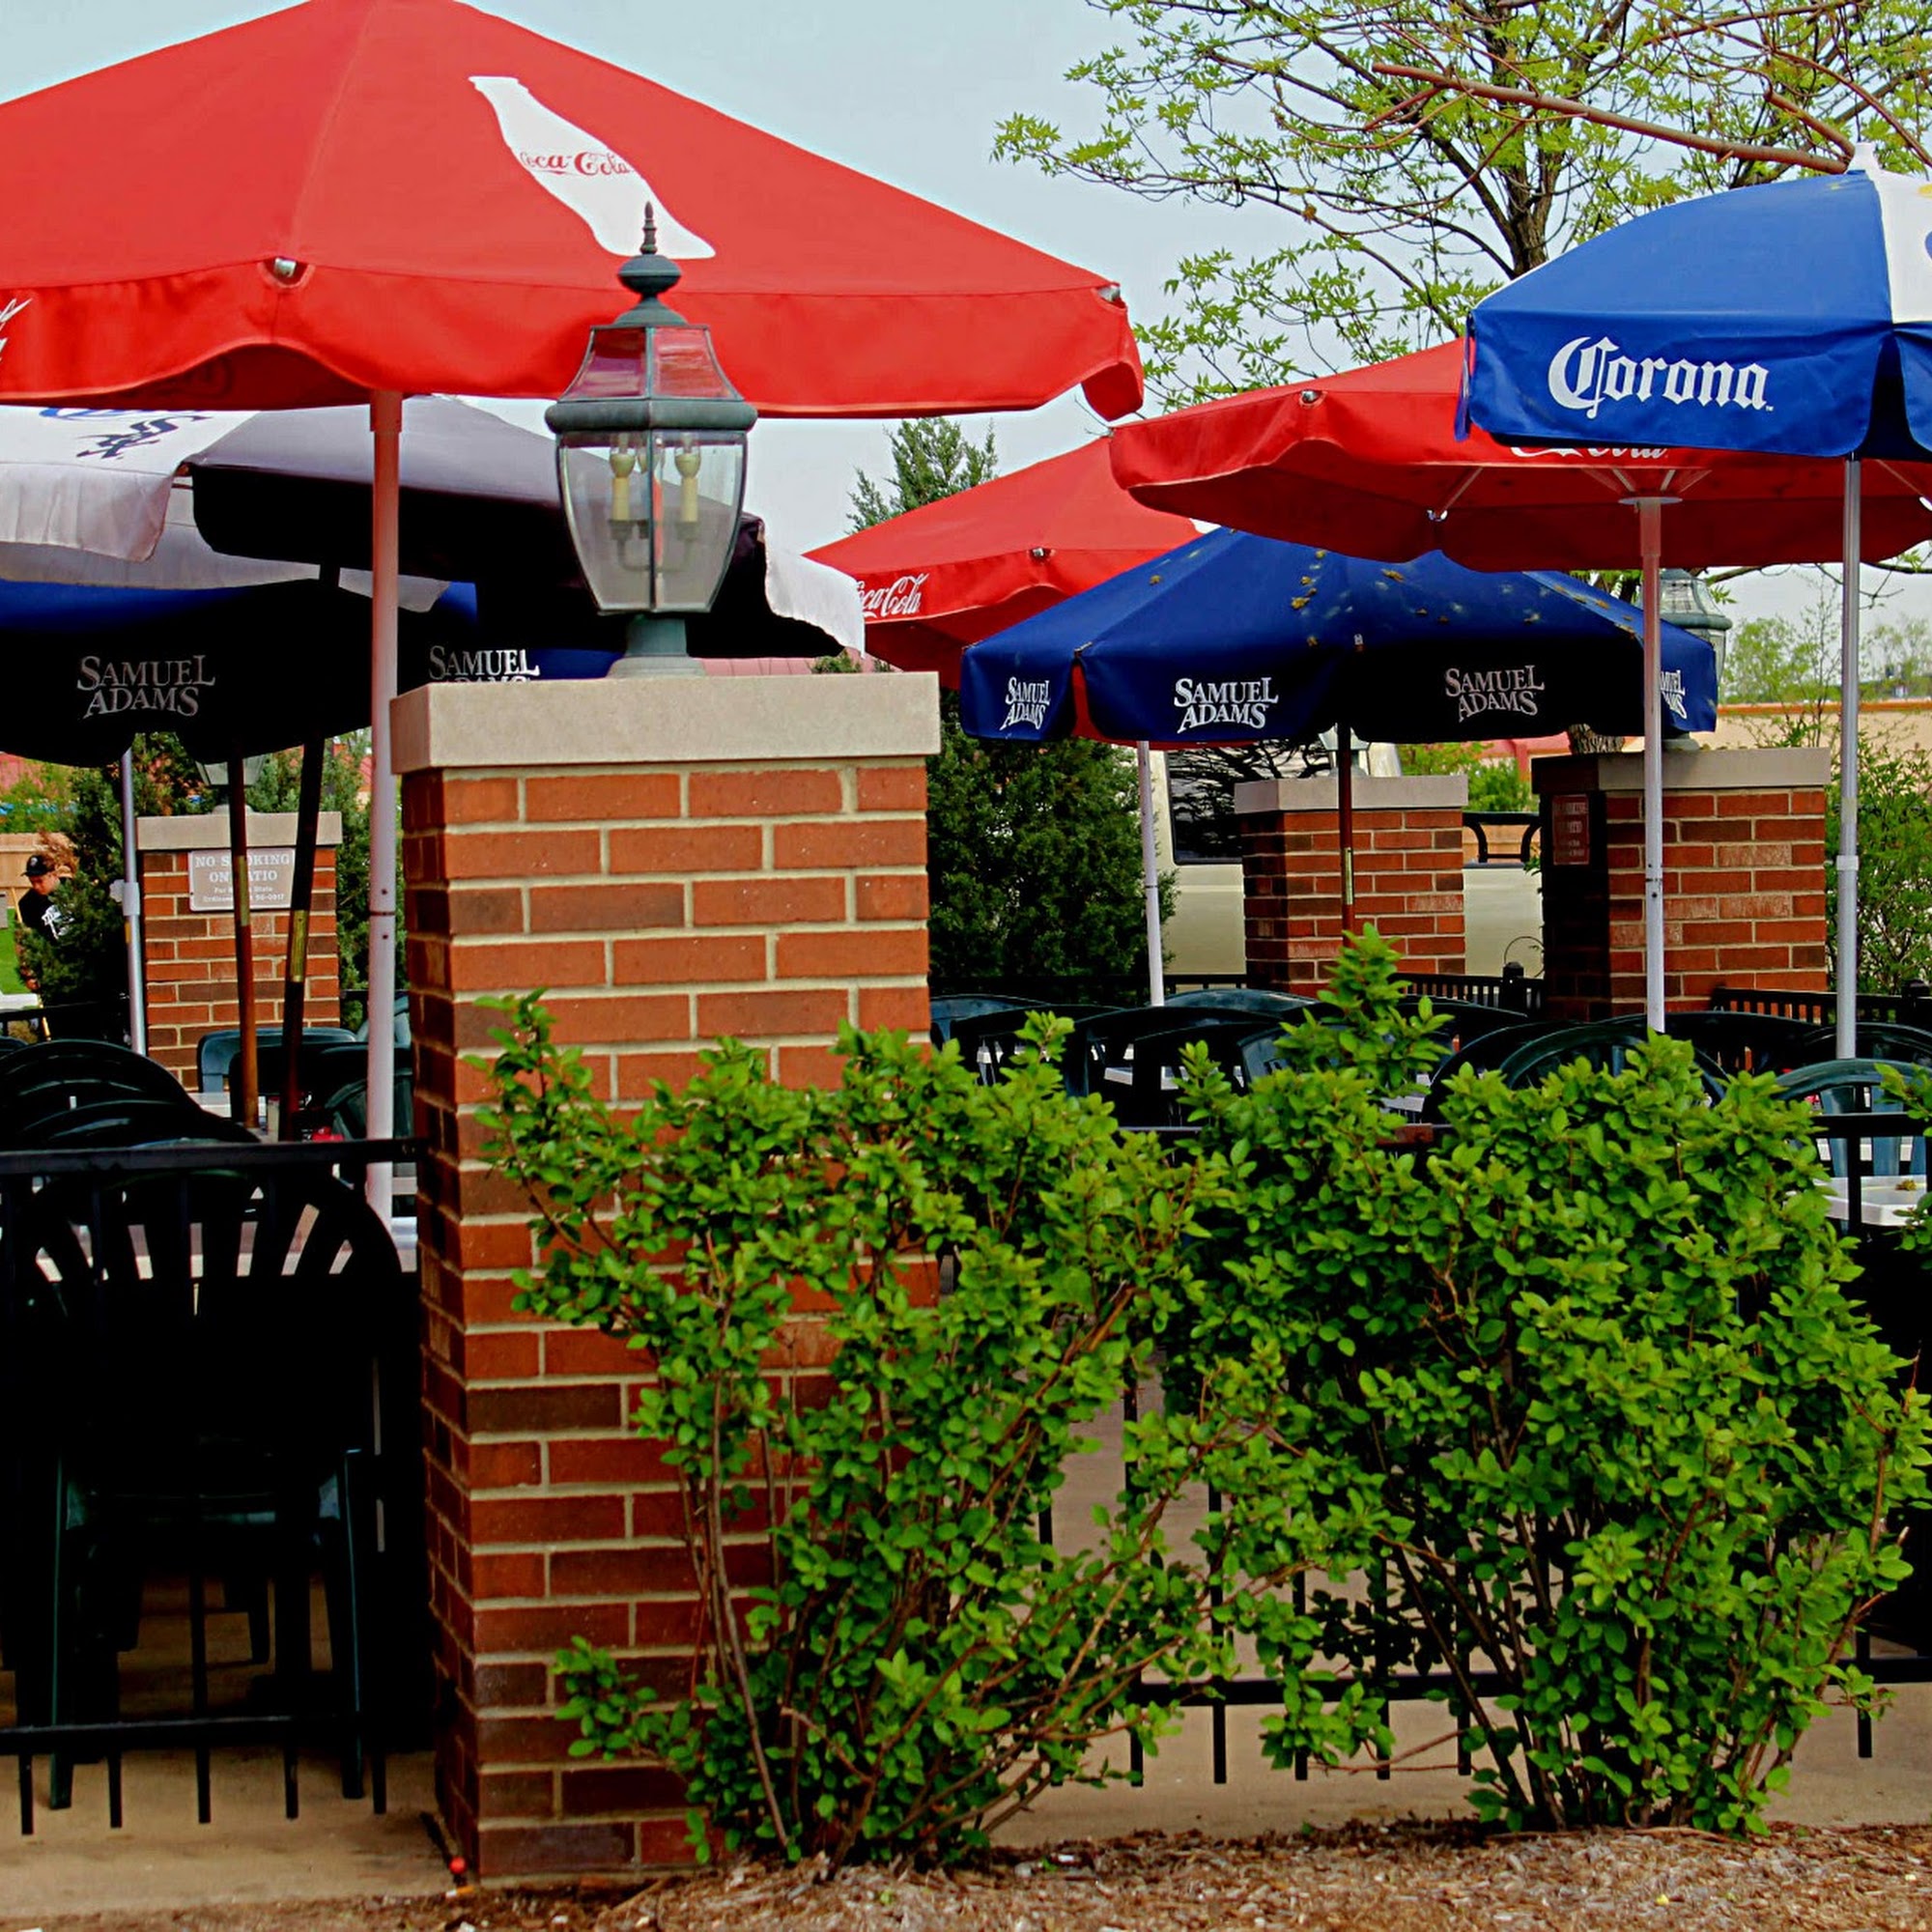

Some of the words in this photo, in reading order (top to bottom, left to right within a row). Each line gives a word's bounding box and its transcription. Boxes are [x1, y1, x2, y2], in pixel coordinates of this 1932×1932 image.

[520, 151, 630, 176] Coca-Cola
[1548, 336, 1770, 419] Corona
[76, 654, 216, 691] SAMUEL
[428, 644, 541, 680] SAMUEL
[1005, 676, 1051, 706] SAMUEL
[1174, 676, 1279, 707] SAMUEL
[1445, 665, 1546, 696] SAMUEL
[82, 686, 199, 719] ADAMS
[999, 703, 1046, 730] ADAMS
[1177, 703, 1268, 733] ADAMS
[1459, 691, 1538, 723] ADAMS
[195, 856, 215, 867] NO
[209, 871, 229, 882] ON
